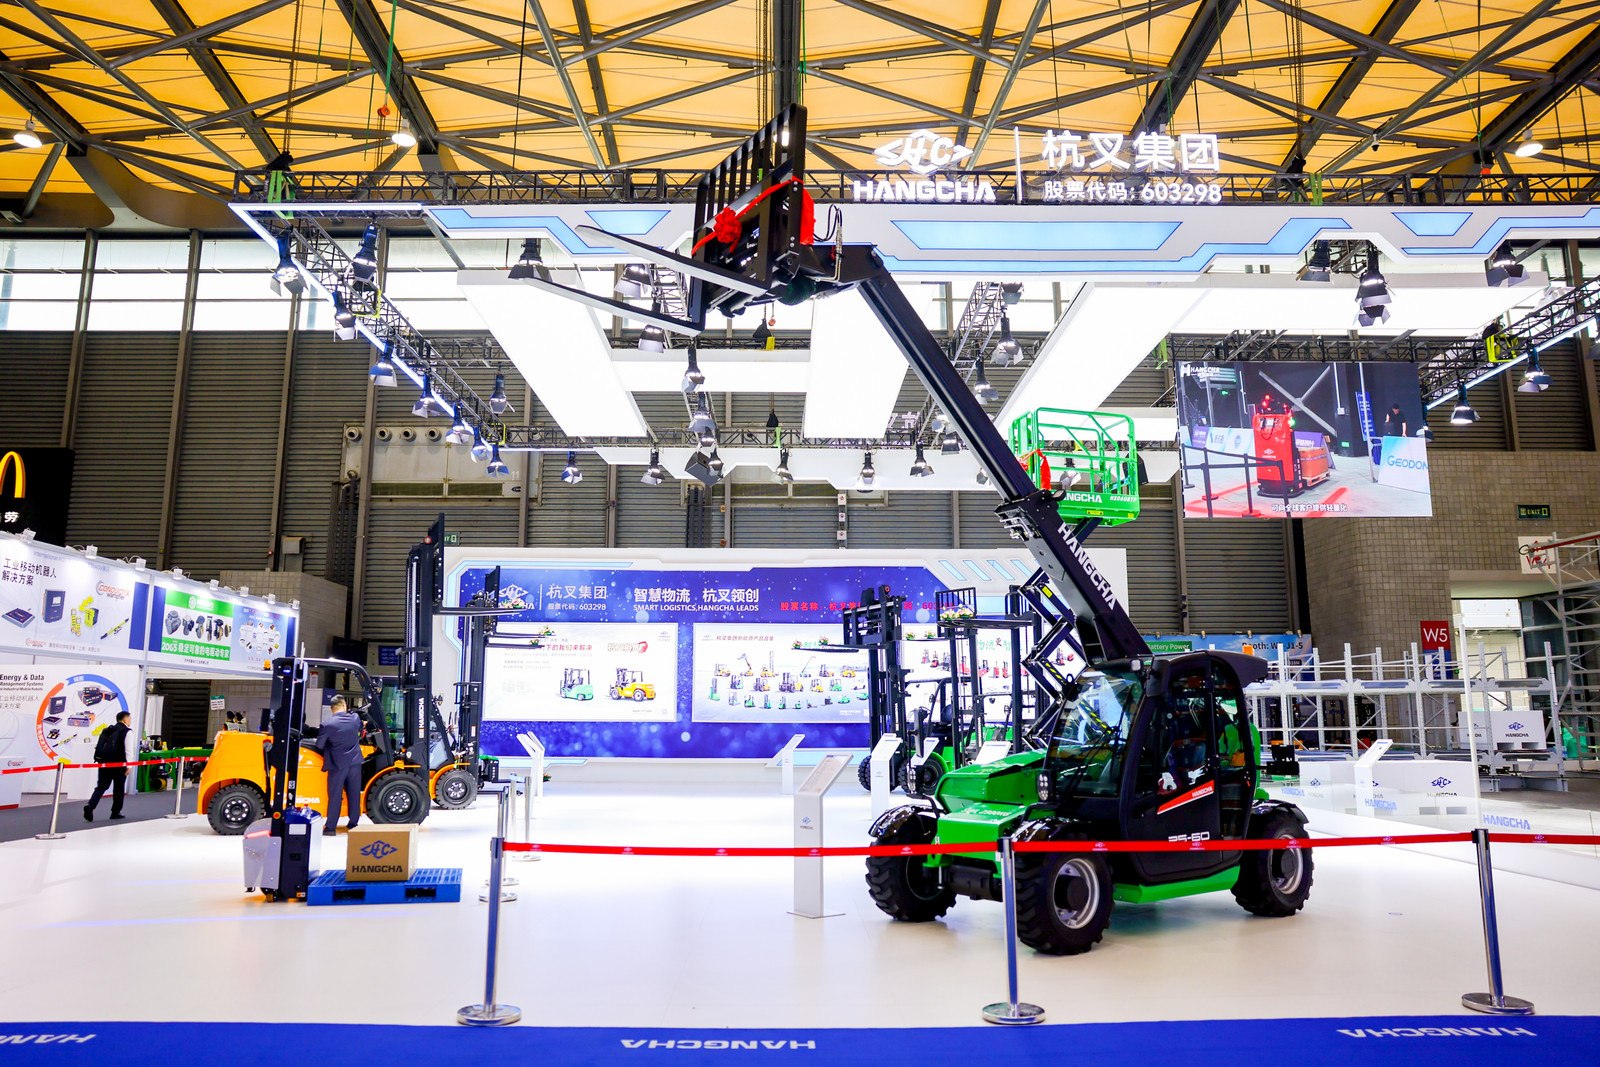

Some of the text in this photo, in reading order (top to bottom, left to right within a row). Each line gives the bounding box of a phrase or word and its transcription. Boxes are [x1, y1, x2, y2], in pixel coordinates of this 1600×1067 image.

[1041, 129, 1221, 172] 杭叉集团
[853, 180, 996, 202] HANGCHA
[0, 511, 20, 523] 劳
[3, 557, 57, 579] 工业移动机器人
[1057, 522, 1118, 611] HANGCHA
[1, 569, 35, 586] 解决方案
[546, 584, 608, 600] 杭叉集团
[633, 588, 760, 603] 智慧物流 杭叉领创
[1423, 628, 1448, 642] W5
[1270, 642, 1304, 650] W-J1-5
[0, 674, 22, 682] Energy
[1281, 786, 1305, 797] HANGCHA
[1364, 798, 1398, 811] HANGCHA
[1482, 813, 1532, 831] HANGCHA
[352, 865, 403, 873] HANGCHA
[1337, 1026, 1538, 1038] HANGCHA
[620, 1039, 816, 1049] HANGCHA
